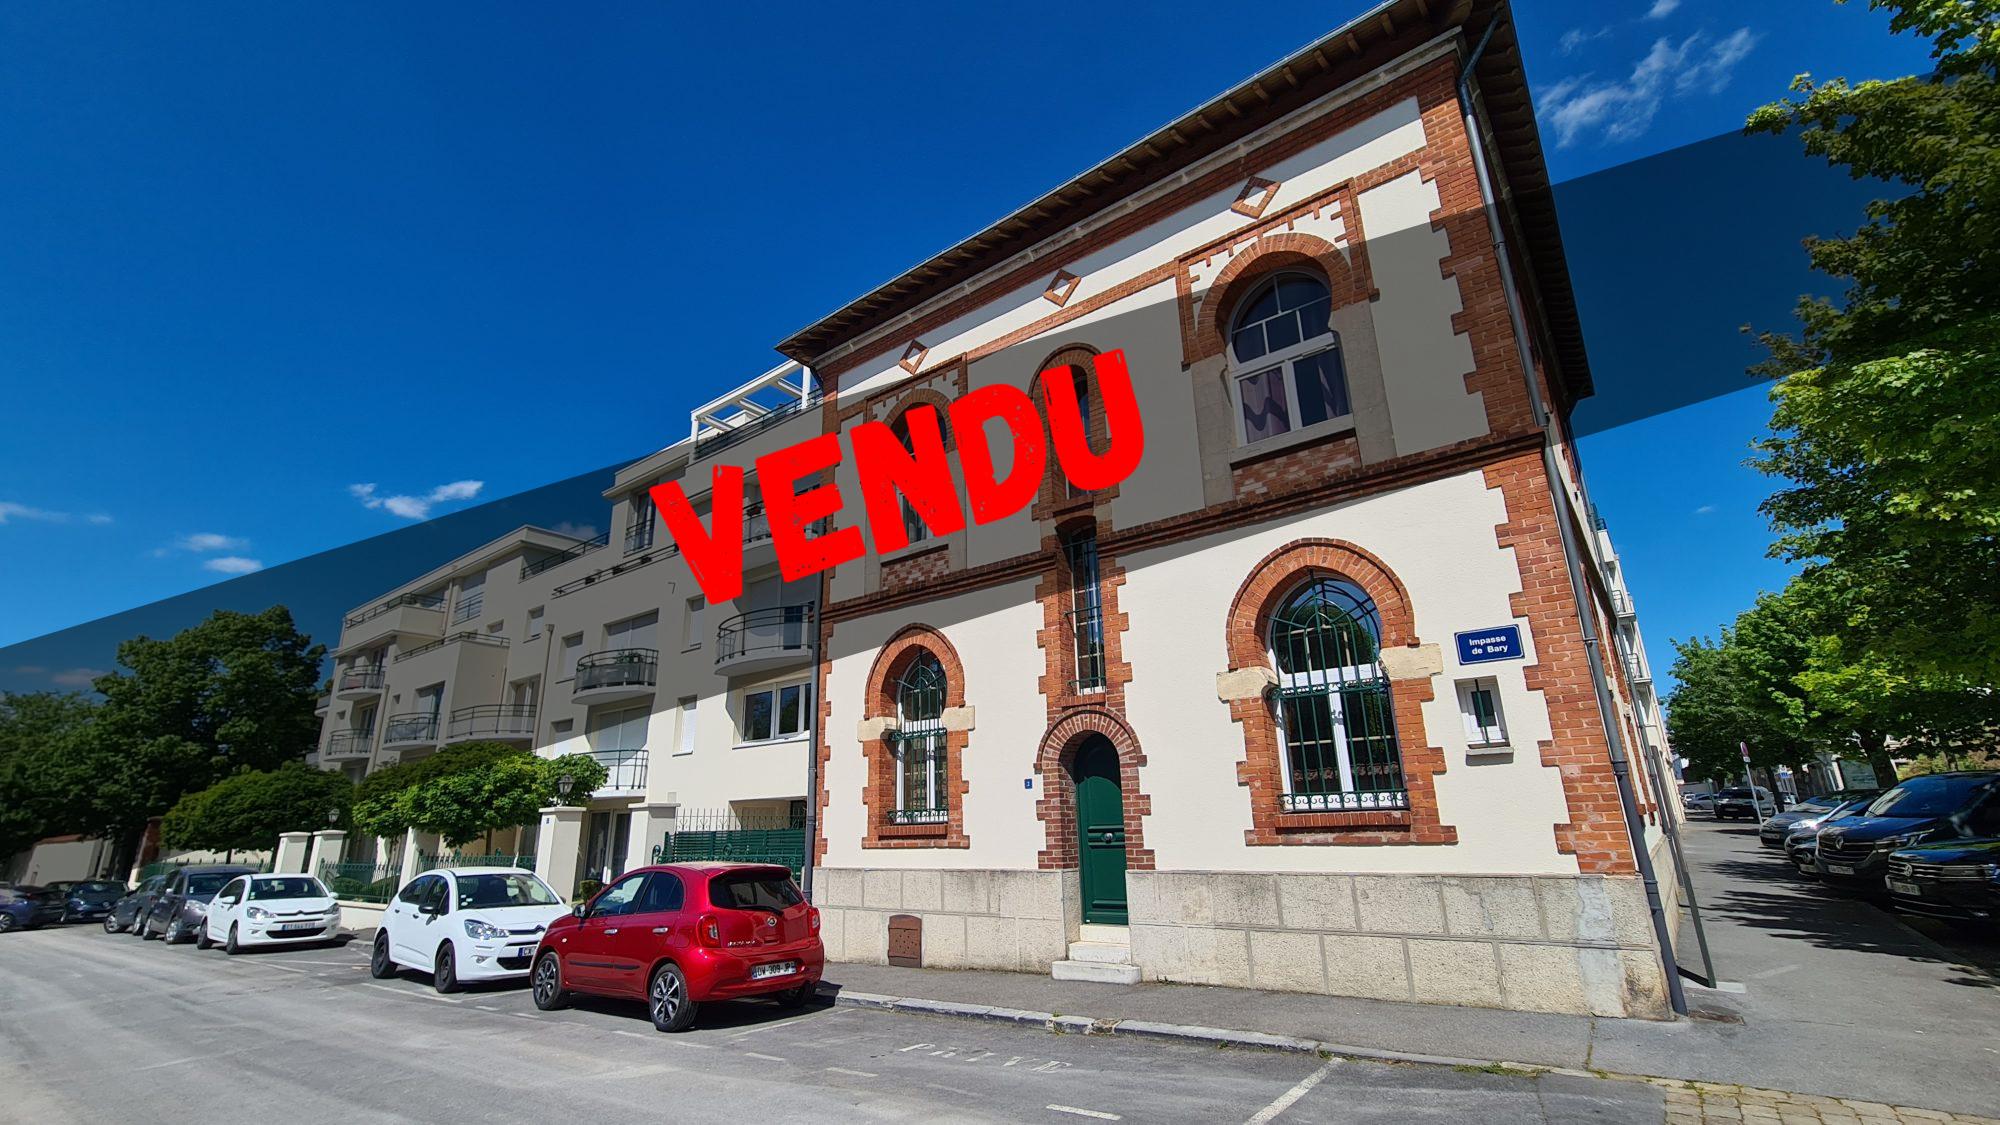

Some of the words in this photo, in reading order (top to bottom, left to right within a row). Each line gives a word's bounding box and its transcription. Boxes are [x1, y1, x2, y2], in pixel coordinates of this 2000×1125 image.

[1469, 635, 1506, 646] Impasse
[1471, 647, 1483, 655] de
[1487, 645, 1508, 653] Bary
